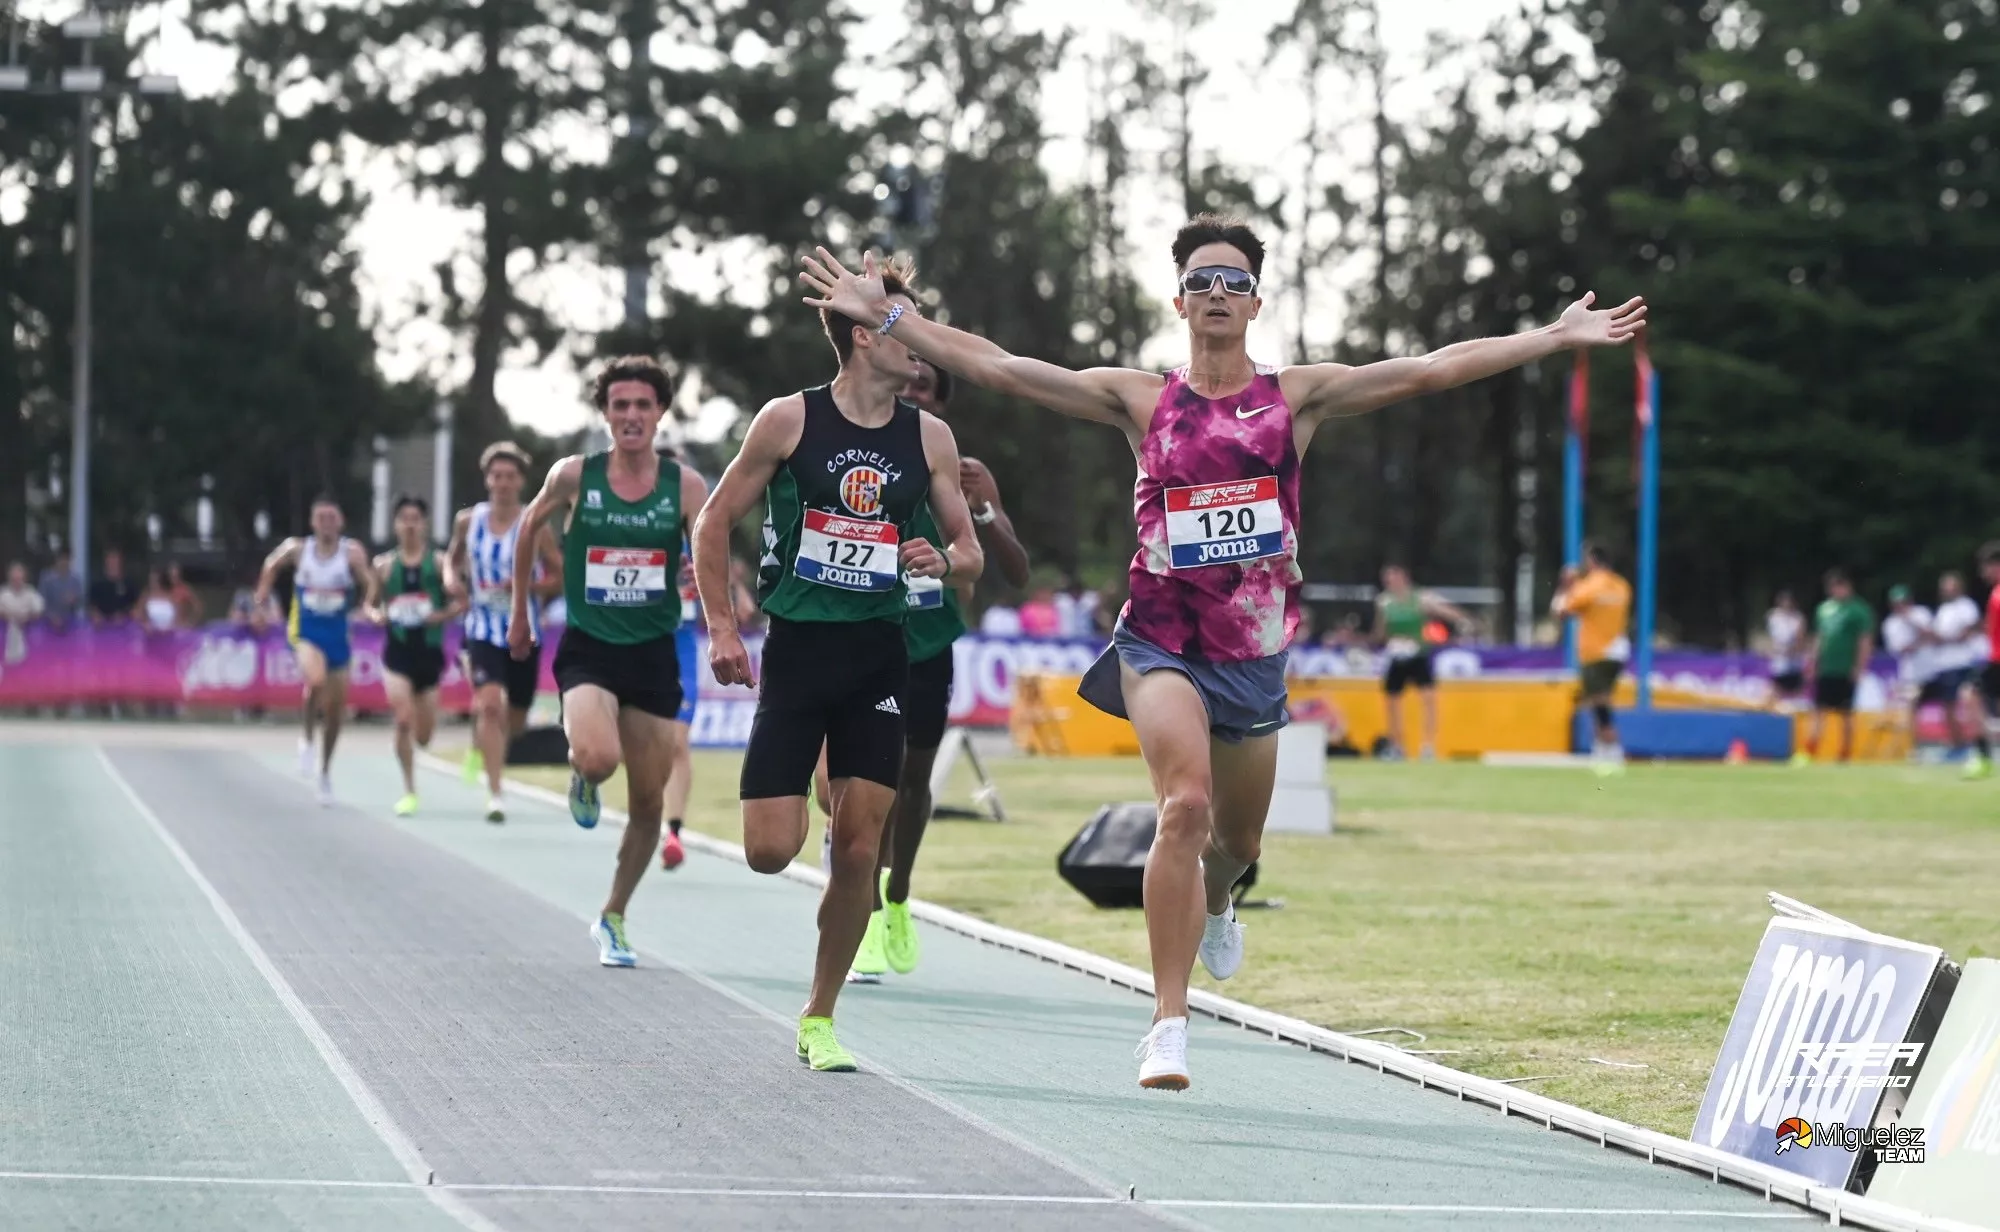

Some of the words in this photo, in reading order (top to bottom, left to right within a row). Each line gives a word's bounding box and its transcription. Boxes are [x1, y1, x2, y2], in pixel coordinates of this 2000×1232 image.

[827, 449, 902, 482] CORNELLA
[1213, 483, 1258, 498] RFEA
[1197, 507, 1256, 539] 120
[826, 540, 875, 568] 127
[613, 568, 640, 587] 67
[875, 704, 901, 715] adidas
